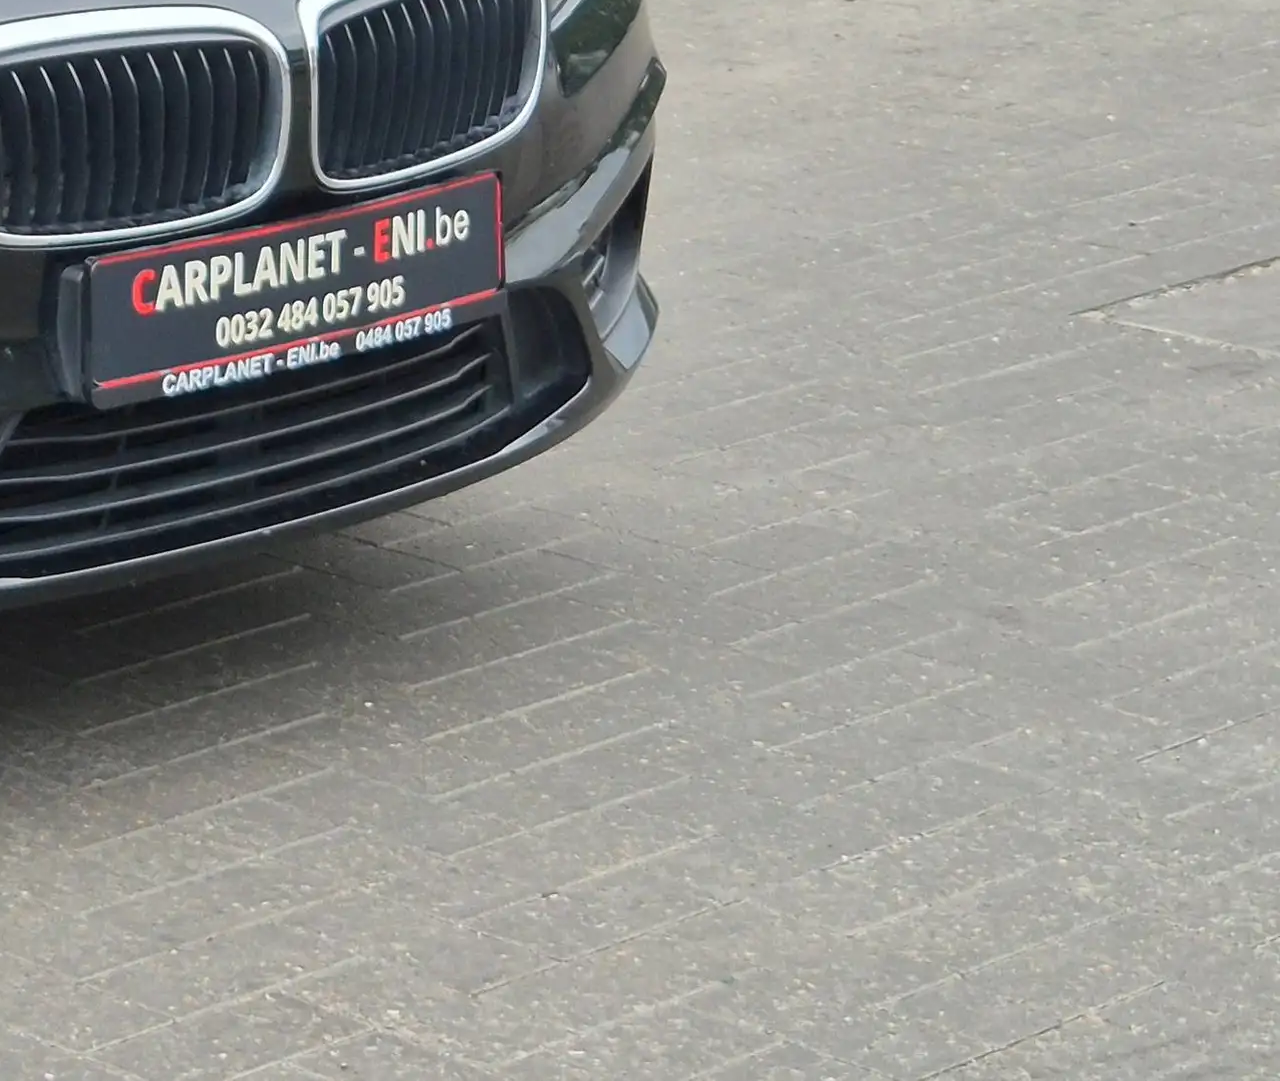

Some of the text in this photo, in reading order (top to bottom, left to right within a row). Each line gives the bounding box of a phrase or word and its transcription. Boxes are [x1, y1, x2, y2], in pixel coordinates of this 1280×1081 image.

[131, 229, 347, 315] CARPLANET
[373, 206, 471, 262] ENI.be
[162, 352, 275, 397] CARPLANET
[287, 340, 341, 369] ENI.be
[356, 328, 393, 352] 0484
[394, 318, 421, 340] 057
[424, 308, 453, 334] 905
[216, 275, 405, 348] 0032 484 057 905
